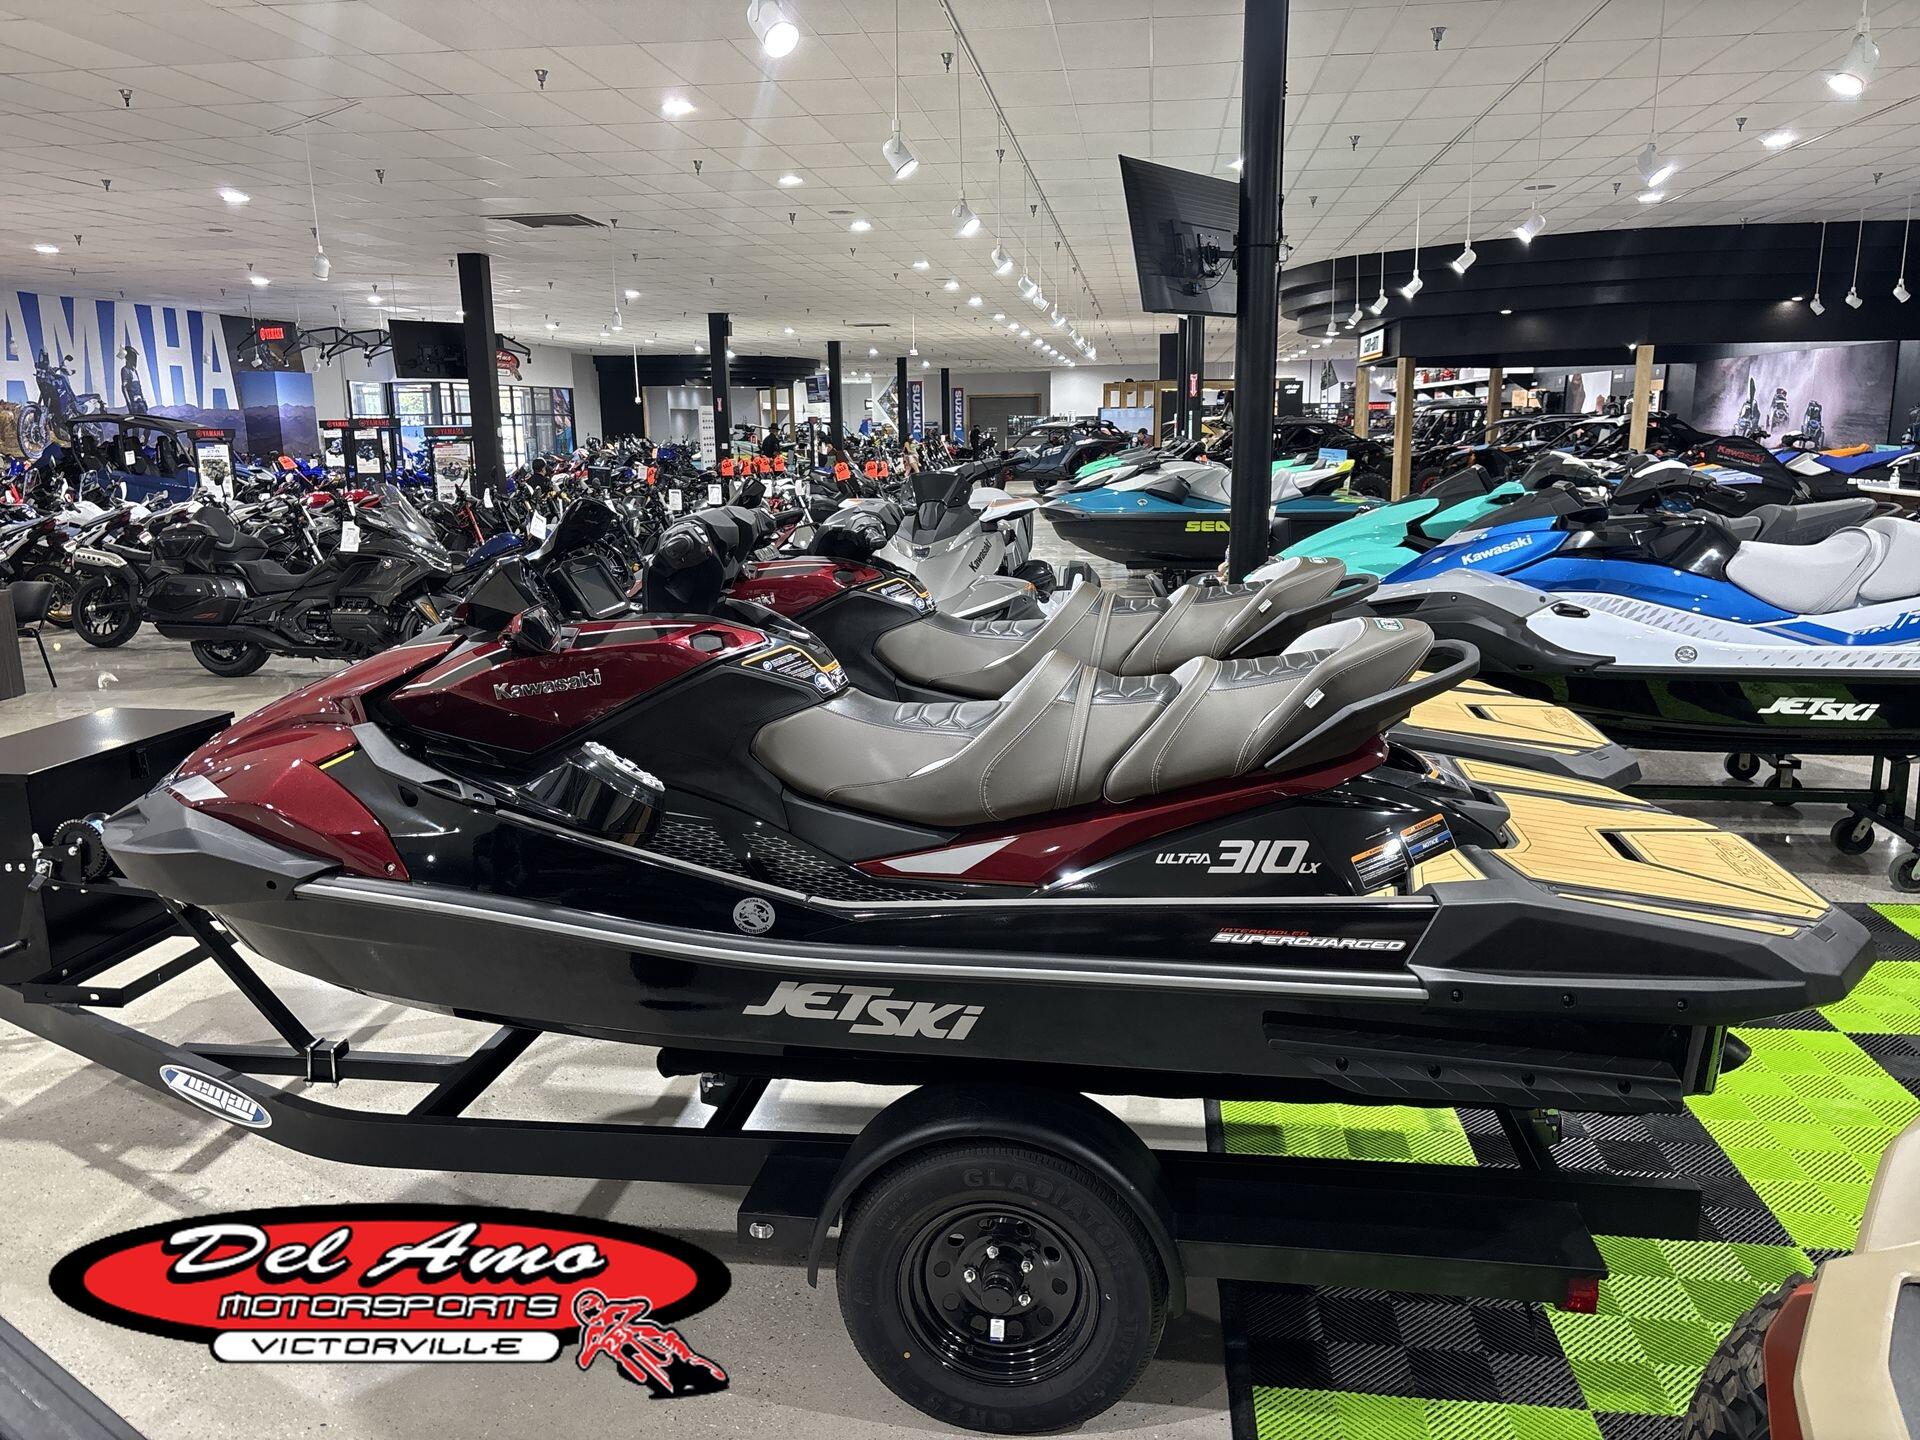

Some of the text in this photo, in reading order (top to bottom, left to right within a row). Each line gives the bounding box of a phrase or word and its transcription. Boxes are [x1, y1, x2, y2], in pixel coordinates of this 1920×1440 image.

[0, 290, 239, 410] AMAHA
[912, 384, 921, 433] SUZUKI
[954, 390, 963, 431] SUZUKI
[1717, 444, 1766, 463] Kawasaki
[1185, 521, 1230, 532] SEA
[968, 538, 992, 573] Kawasaki
[1461, 534, 1533, 566] Kawasaki
[493, 667, 602, 700] Kawasaki
[1155, 840, 1322, 874] ULTRA 310 LX
[1422, 837, 1439, 849] NOTICE
[738, 923, 770, 934] EMISSION
[1210, 932, 1406, 951] SUPERCHARGED
[1220, 927, 1310, 937] INTERCOOLED
[961, 1167, 1131, 1267] GLADIATOR
